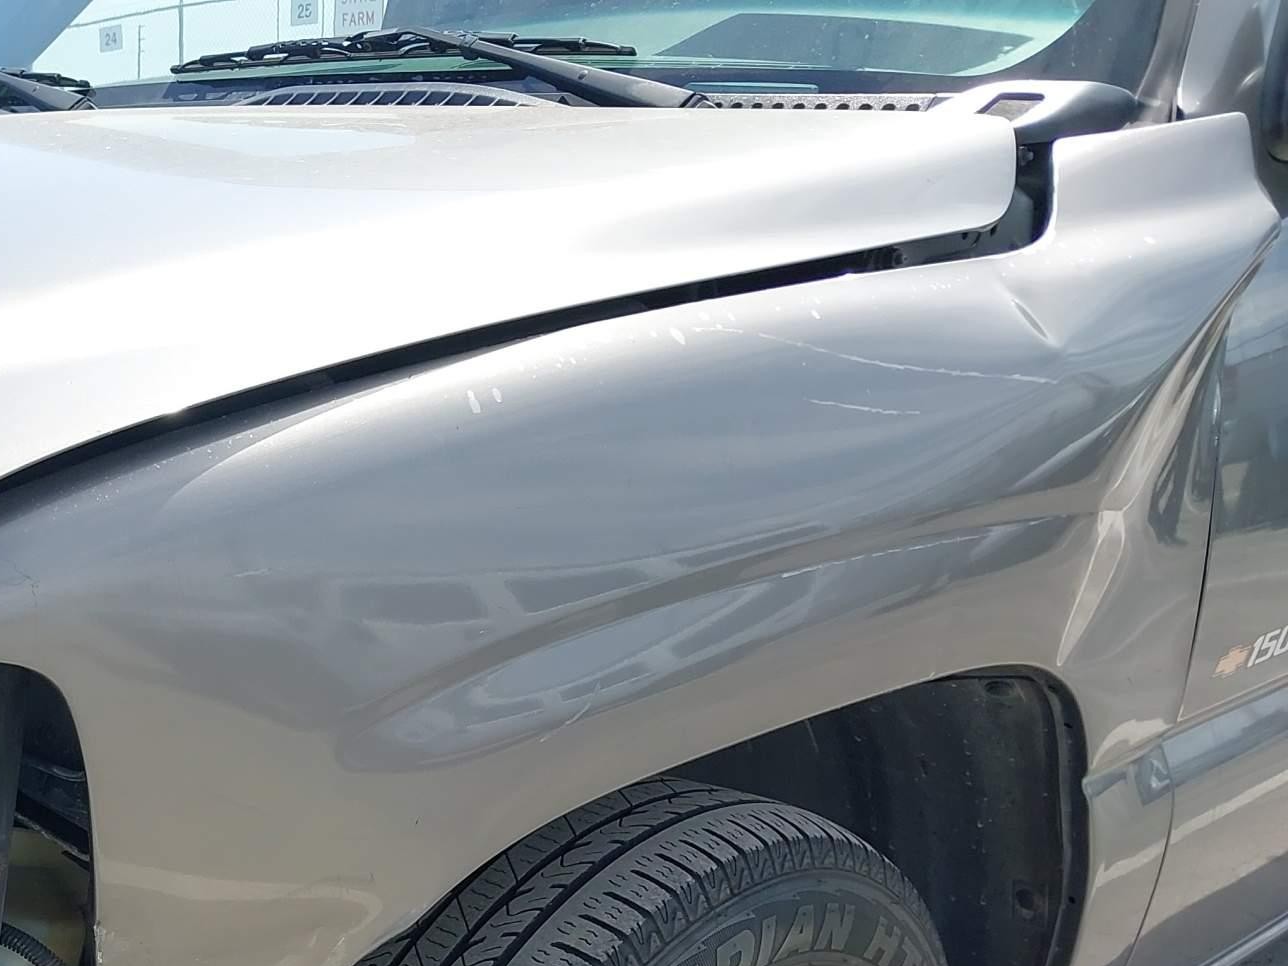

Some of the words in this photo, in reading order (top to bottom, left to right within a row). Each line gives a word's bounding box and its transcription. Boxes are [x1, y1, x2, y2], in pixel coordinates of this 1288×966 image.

[297, 3, 313, 19] 25
[342, 10, 375, 27] FARM
[104, 31, 118, 47] 24
